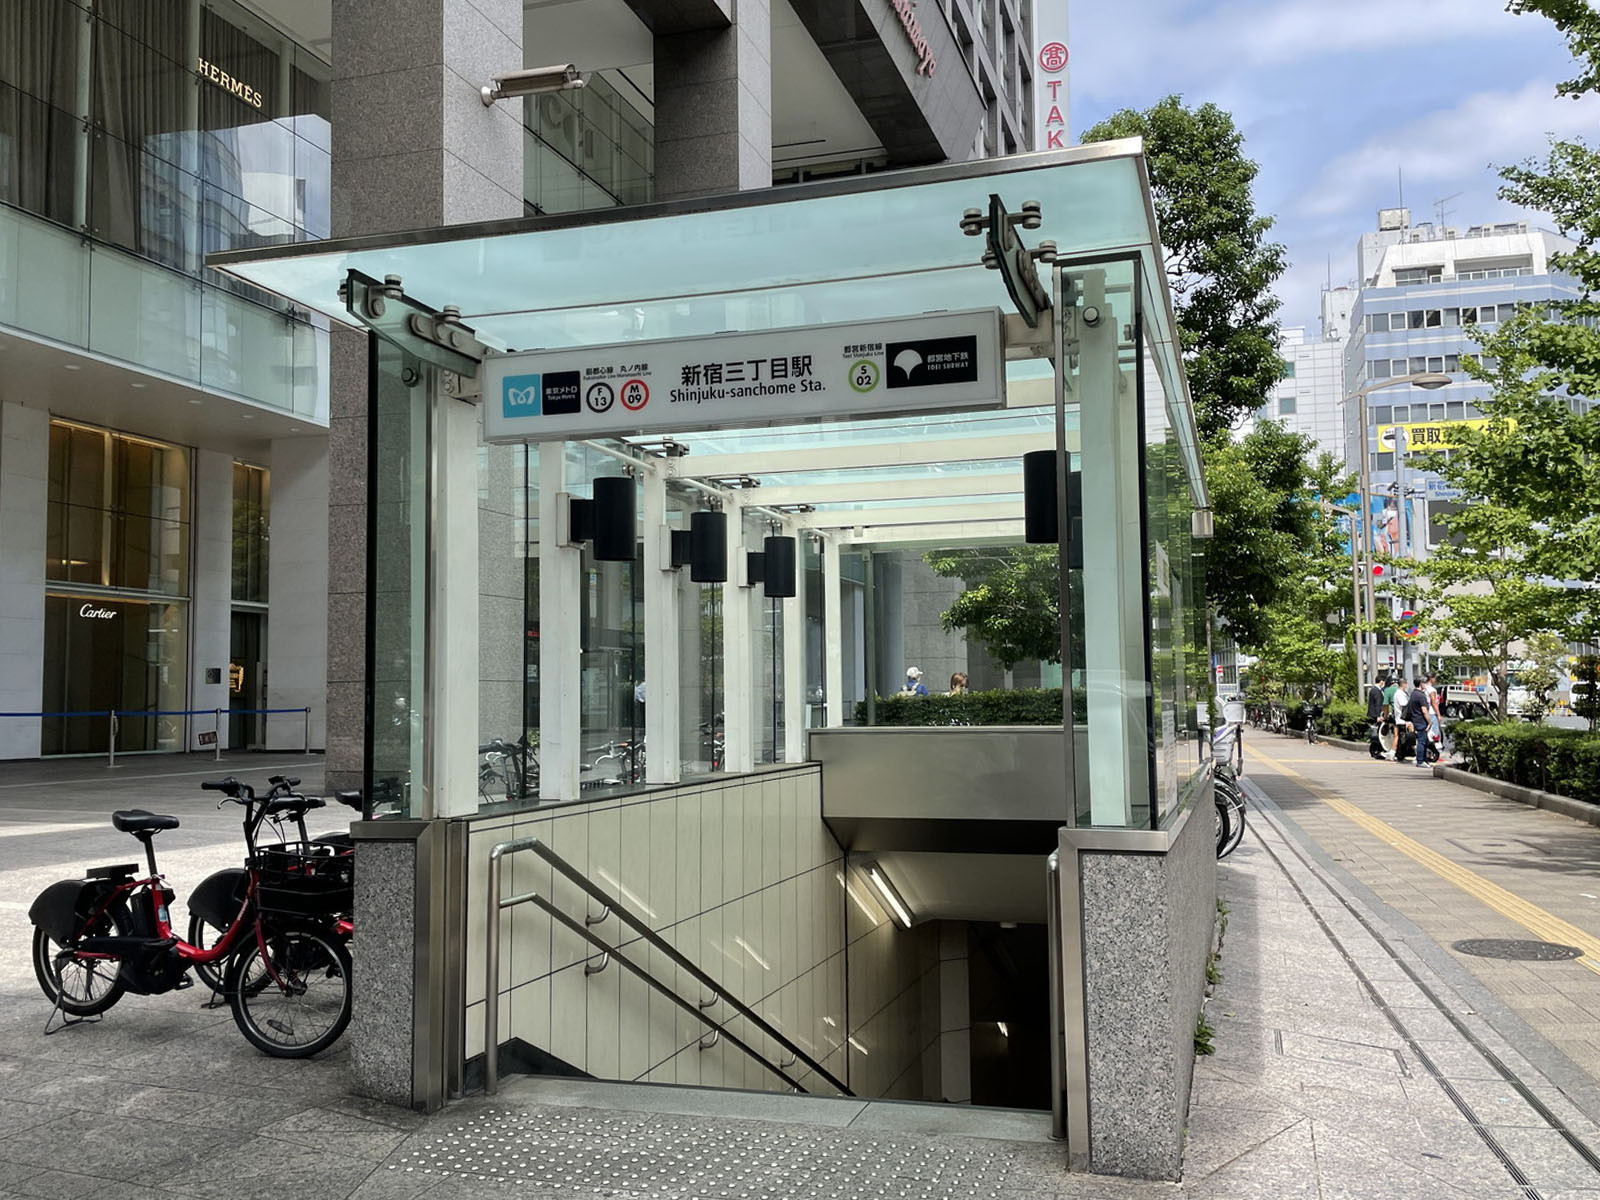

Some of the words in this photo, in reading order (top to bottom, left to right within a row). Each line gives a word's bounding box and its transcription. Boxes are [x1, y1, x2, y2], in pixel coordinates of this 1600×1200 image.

[927, 351, 969, 363] 都営地下鉄
[681, 355, 813, 386] 新宿三丁目駅
[861, 365, 867, 375] S
[943, 361, 969, 370] SUBWAY
[856, 375, 872, 386] 02
[597, 388, 603, 396] F
[630, 385, 640, 393] M
[670, 382, 796, 404] Shinjuku-sanchome
[800, 379, 826, 392] Sta.
[594, 397, 607, 406] 13
[628, 394, 642, 404] 09
[80, 603, 117, 619] Cartier
